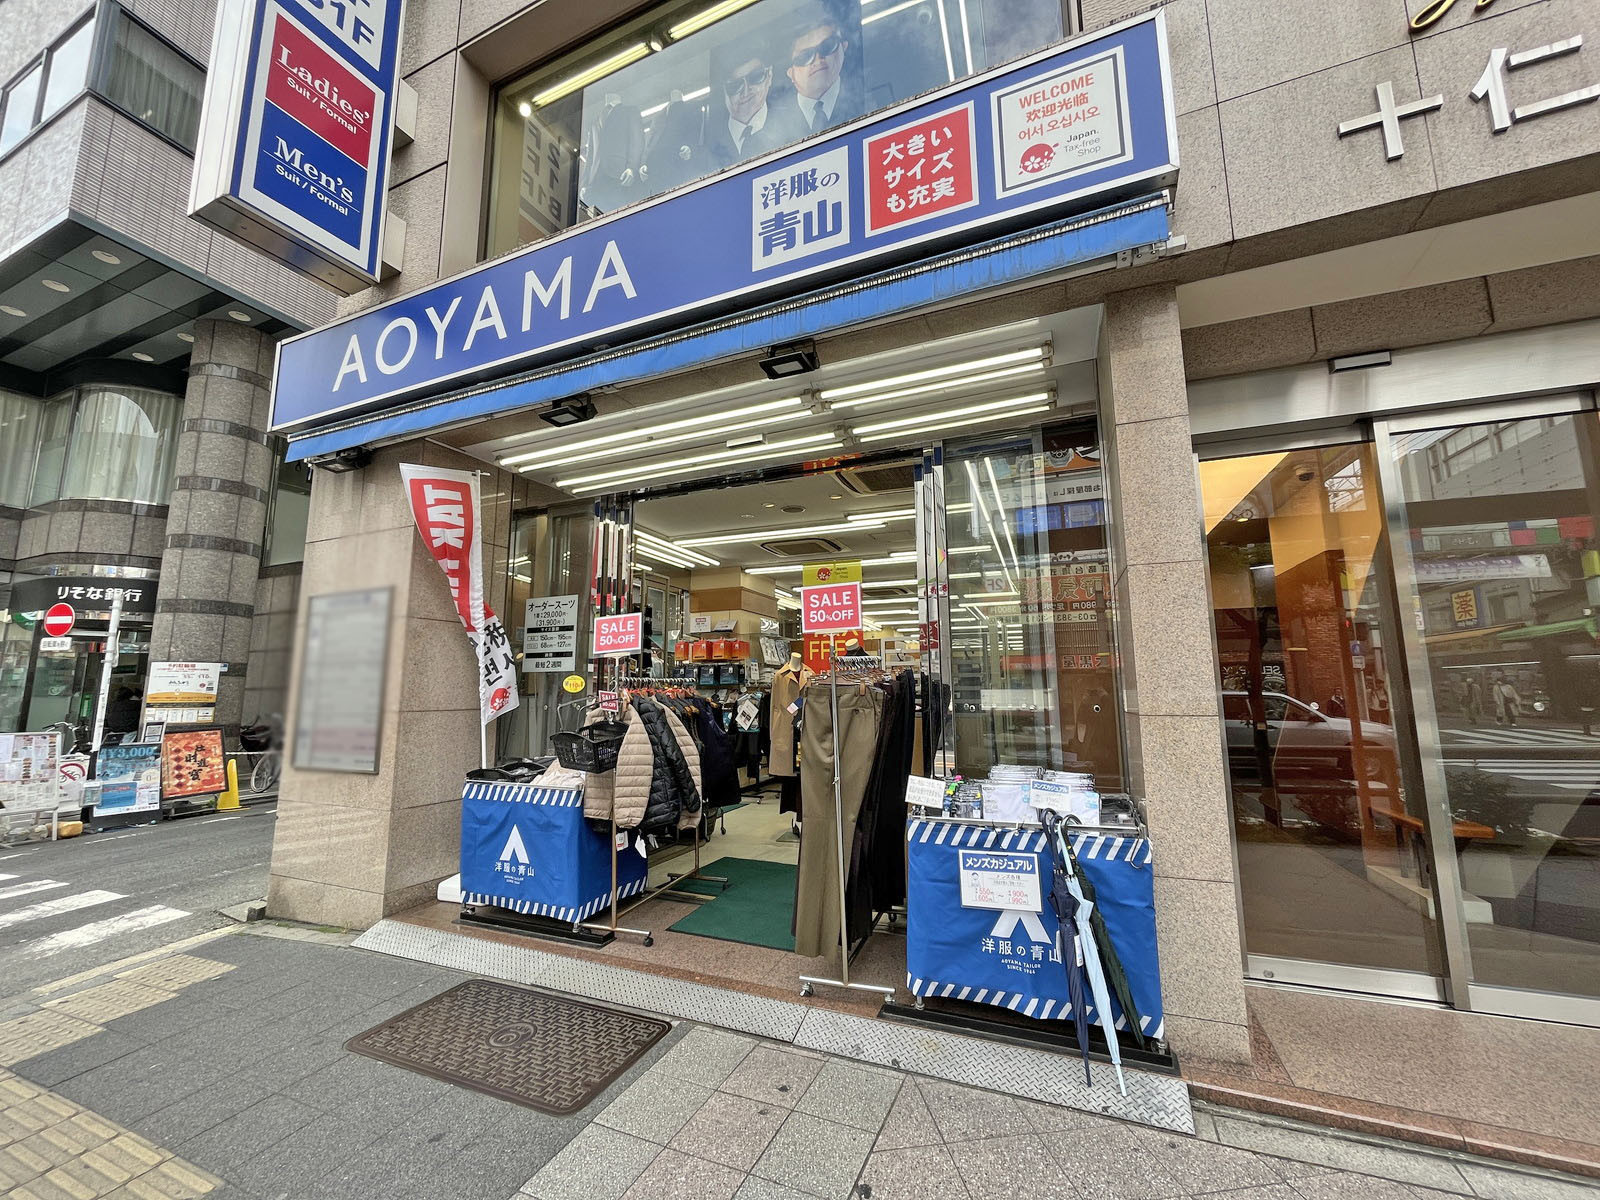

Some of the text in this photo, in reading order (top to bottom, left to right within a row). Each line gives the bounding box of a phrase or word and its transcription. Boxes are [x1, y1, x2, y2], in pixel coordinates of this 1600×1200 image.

[277, 44, 370, 125] Ladies'
[1019, 73, 1094, 109] WELCOME
[286, 77, 310, 100] Suit
[319, 102, 357, 134] Formal
[1026, 92, 1089, 123] 欢迎光临
[1018, 106, 1100, 140] 어서 오십시오
[881, 125, 953, 165] 大きい
[1063, 137, 1101, 153] Tax-free
[1077, 145, 1101, 157] Shop
[274, 136, 353, 203] Men's
[884, 148, 954, 189] サイズ
[275, 164, 300, 186] Suit
[309, 185, 348, 216] Formal
[760, 168, 840, 210] 洋服の
[886, 176, 956, 213] も充実
[758, 199, 843, 257] 青山
[332, 240, 638, 392] AOYAMA
[423, 484, 465, 549] TAX
[57, 586, 142, 602] りそな銀行
[528, 600, 576, 612] オーダースーツ
[810, 591, 852, 608] SALE
[601, 620, 635, 634] SALE
[810, 609, 854, 623] 50%OFF
[600, 634, 636, 646] 50%OFF
[601, 693, 616, 701] SALE
[494, 861, 535, 877] 洋服の青山
[965, 856, 1033, 871] メンズカジュアル
[981, 937, 1061, 965] 洋服の青山
[1007, 964, 1022, 972] SINCE
